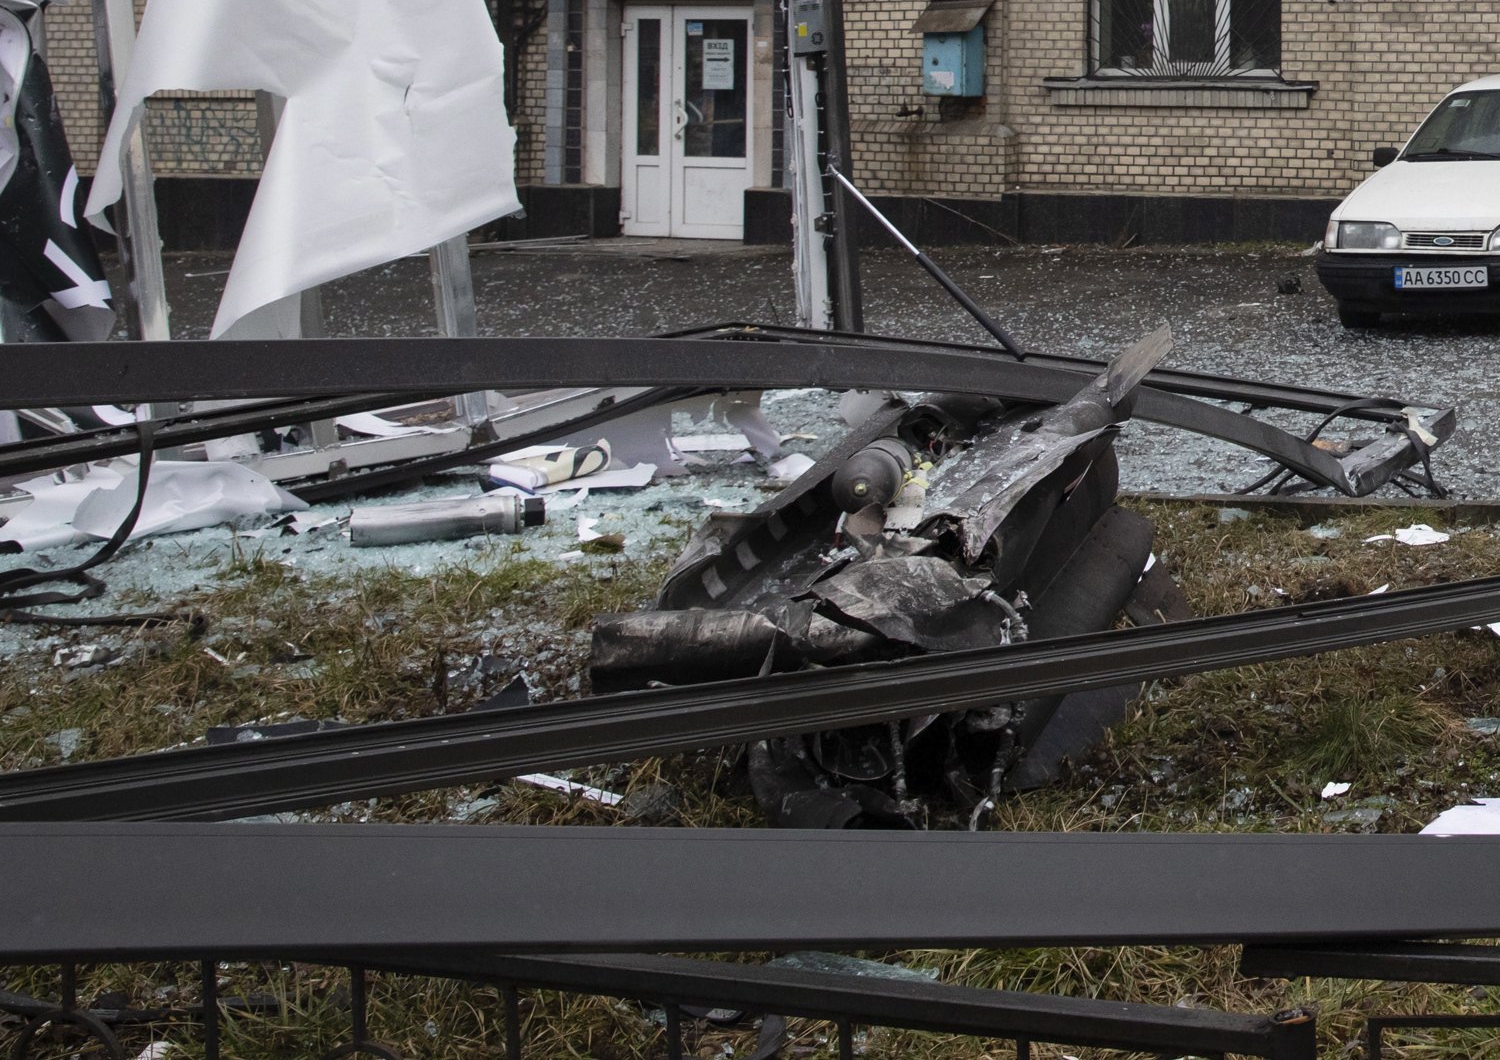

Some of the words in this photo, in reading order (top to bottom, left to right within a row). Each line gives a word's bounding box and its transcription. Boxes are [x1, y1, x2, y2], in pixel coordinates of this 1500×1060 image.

[707, 42, 728, 51] ВХІД
[1404, 271, 1424, 285] AA
[1426, 270, 1460, 285] 6350
[1463, 270, 1485, 284] CC
